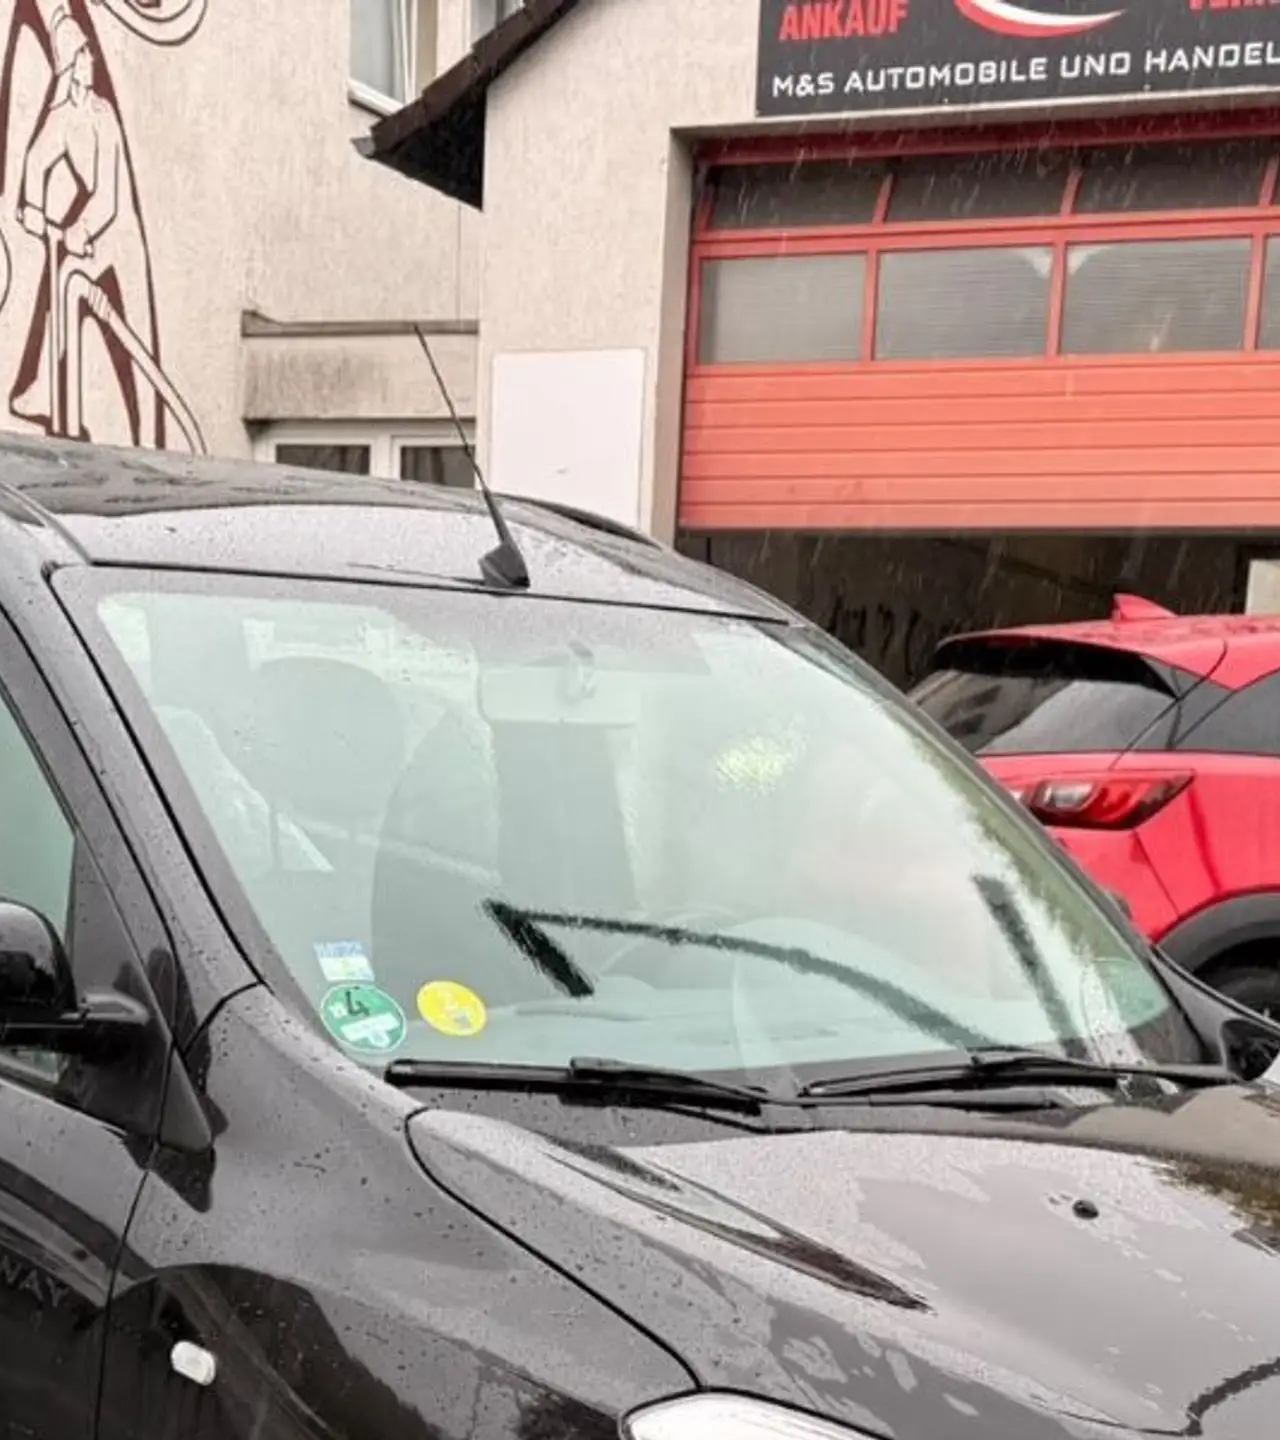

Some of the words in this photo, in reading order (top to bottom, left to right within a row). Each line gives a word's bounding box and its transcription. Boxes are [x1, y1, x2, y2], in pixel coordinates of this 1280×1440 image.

[779, 0, 908, 40] ANKAUF
[772, 73, 834, 97] M&S
[844, 57, 1048, 94] AUTOMOBILE
[1060, 52, 1131, 79] UND
